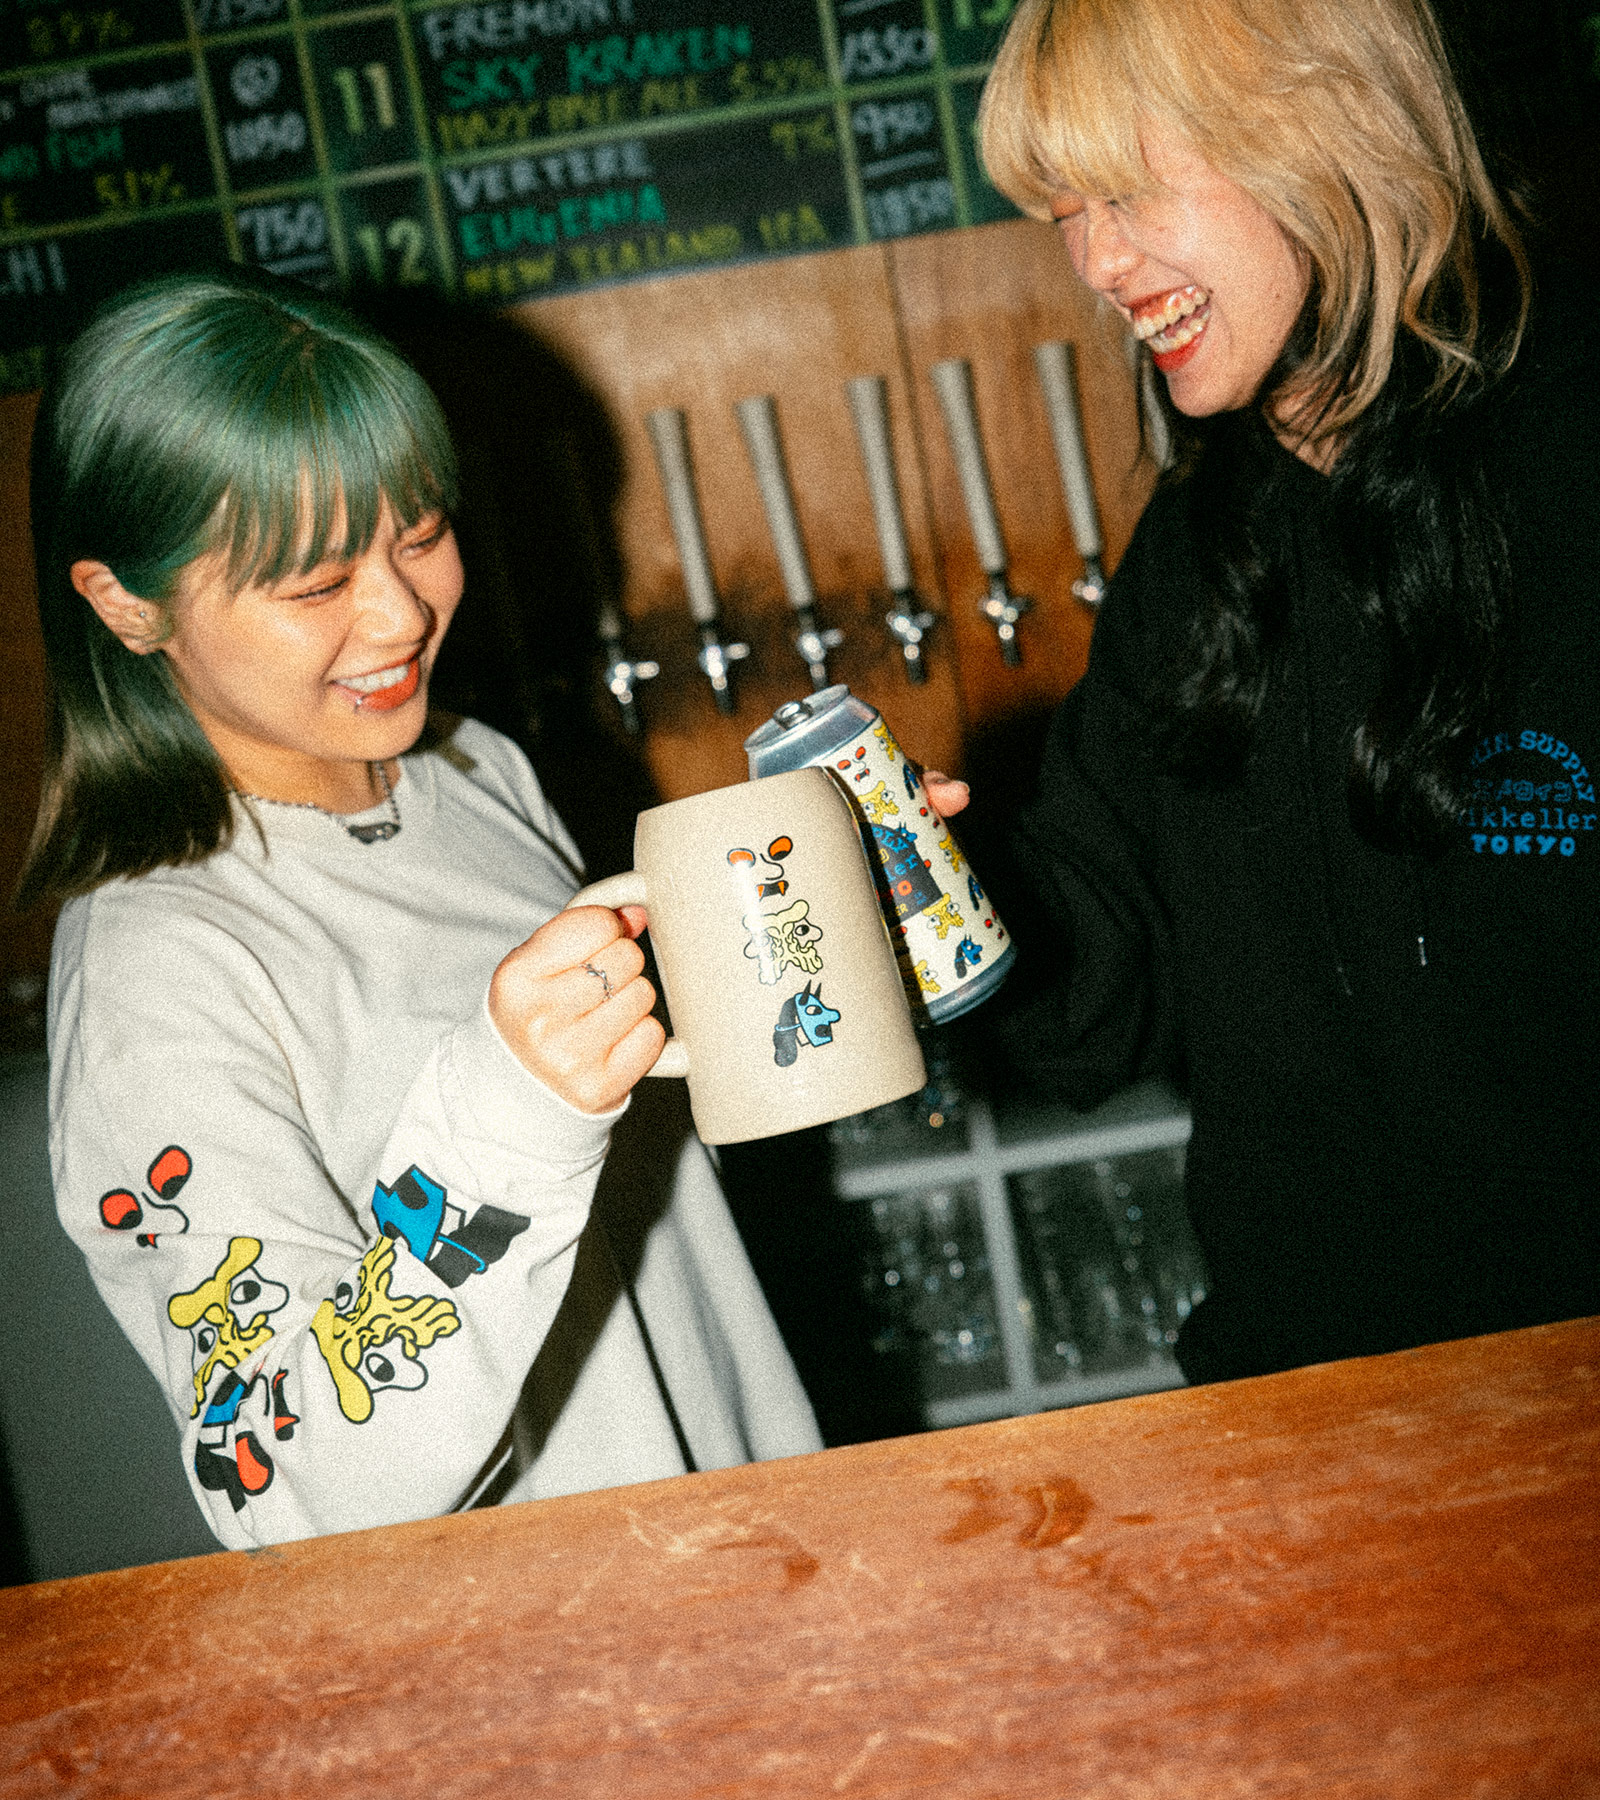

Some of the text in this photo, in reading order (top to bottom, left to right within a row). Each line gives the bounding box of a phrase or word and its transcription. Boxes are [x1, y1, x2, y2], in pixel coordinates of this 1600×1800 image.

[424, 0, 634, 60] FREMONT
[441, 22, 752, 109] SKY KRAKEN
[333, 62, 397, 136] 11
[356, 218, 427, 285] 12
[460, 182, 666, 262] EUGENIA
[1519, 729, 1596, 803] SUPPLY
[1470, 832, 1576, 857] TOKYO
